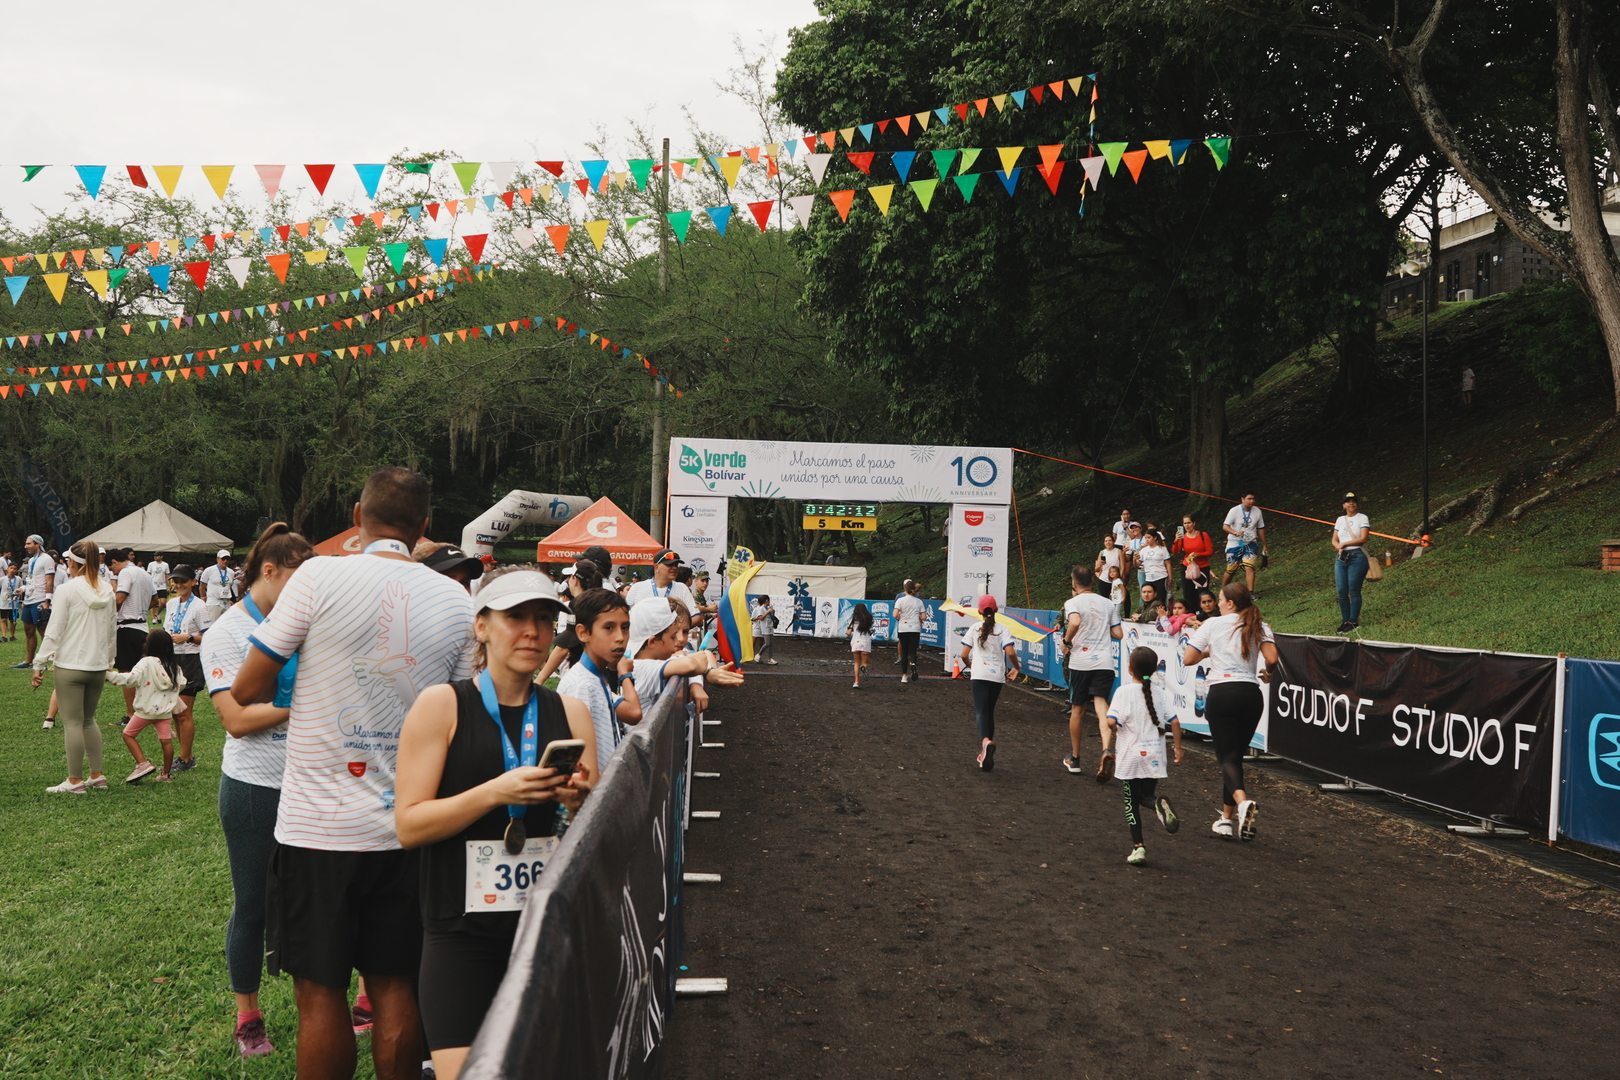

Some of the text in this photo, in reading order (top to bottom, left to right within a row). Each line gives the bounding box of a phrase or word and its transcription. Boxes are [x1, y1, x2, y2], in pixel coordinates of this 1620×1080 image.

[680, 455, 699, 466] 5K
[704, 449, 747, 468] Verde
[789, 451, 896, 473] Marcamos el paso
[705, 469, 746, 481] Bolívar
[951, 456, 997, 488] 10
[781, 470, 905, 488] unidos por una causa
[806, 504, 876, 516] 0:42:12
[491, 521, 511, 532] LUA
[819, 519, 864, 528] 5 Km
[683, 536, 713, 544] Kingspan
[610, 552, 653, 560] GATORADE
[1277, 681, 1374, 736] STUDIO F
[353, 725, 392, 739] Marcamos
[1391, 704, 1537, 770] STUDIO F
[343, 741, 371, 751] unidos
